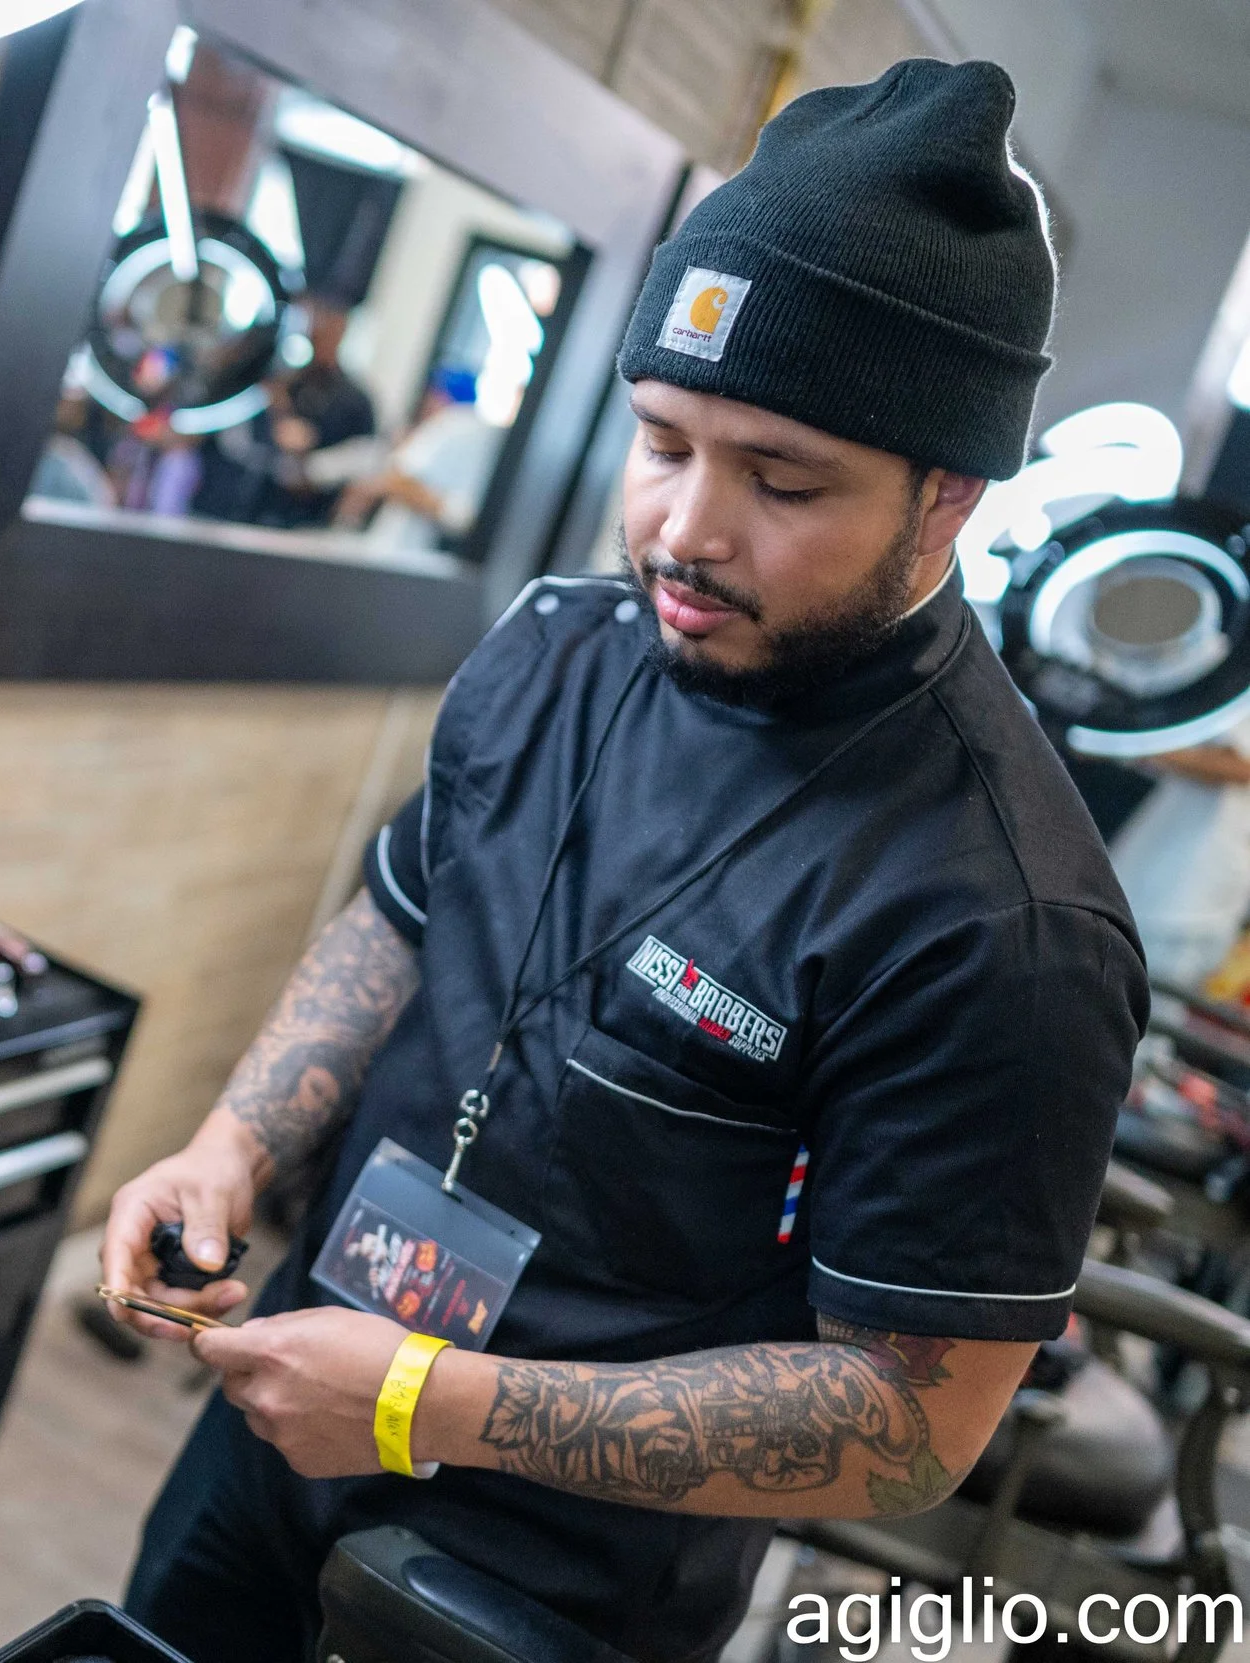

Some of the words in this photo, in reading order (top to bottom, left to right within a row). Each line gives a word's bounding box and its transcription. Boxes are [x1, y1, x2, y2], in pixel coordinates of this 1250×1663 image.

[672, 327, 712, 342] carhartt
[632, 940, 687, 991] NISSI
[688, 978, 782, 1054] BARBERS
[728, 1034, 769, 1063] SUPPLIES
